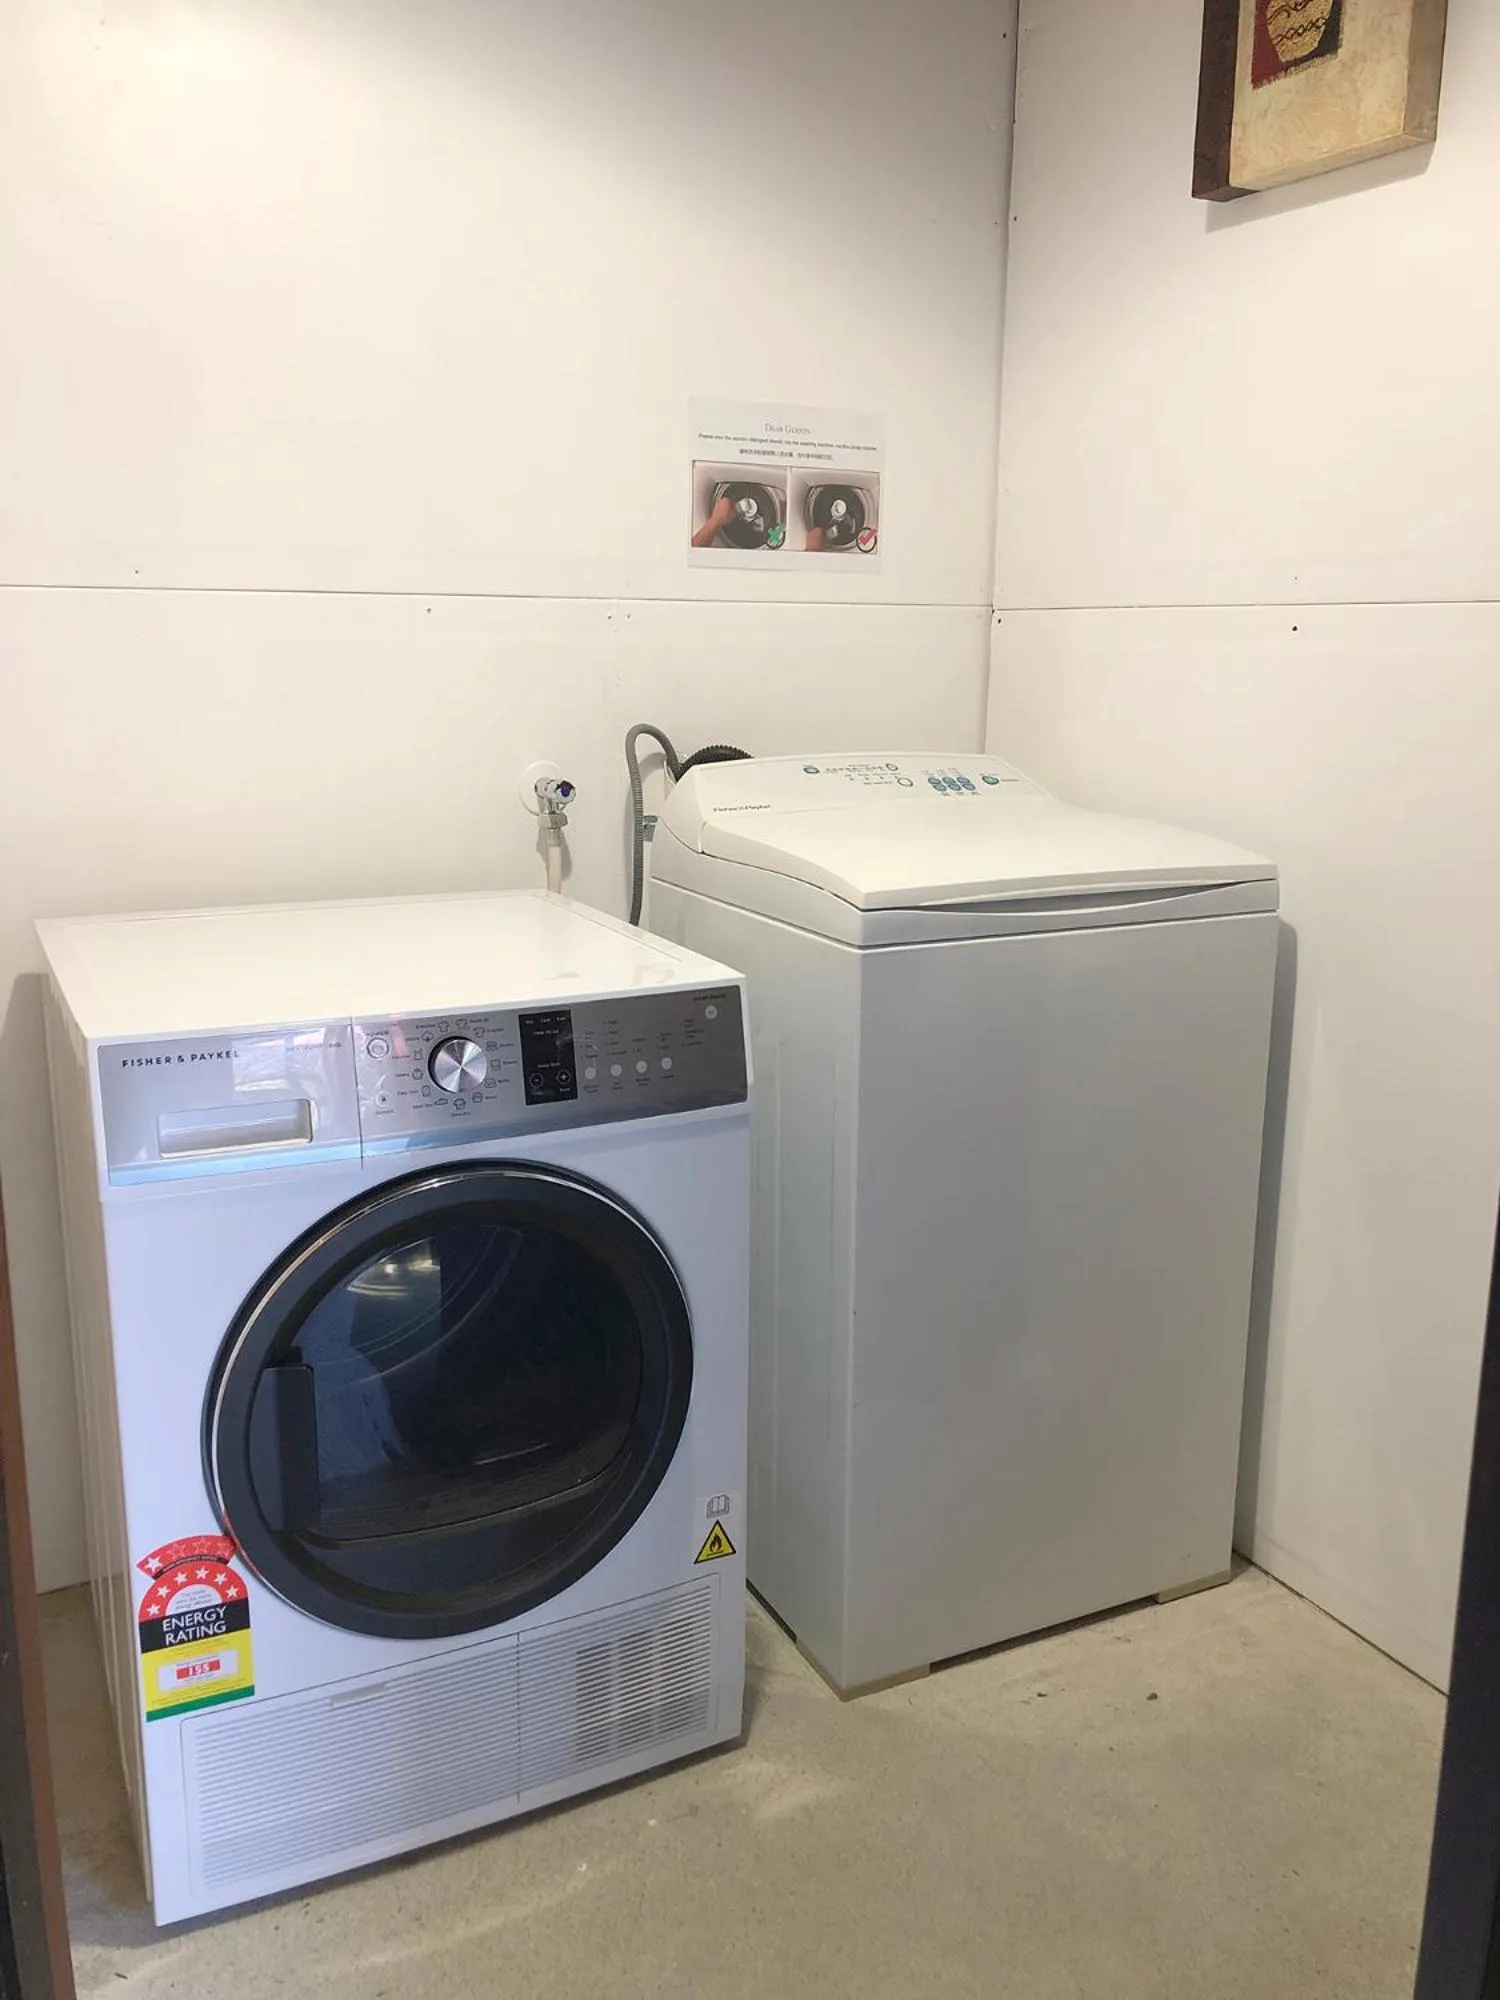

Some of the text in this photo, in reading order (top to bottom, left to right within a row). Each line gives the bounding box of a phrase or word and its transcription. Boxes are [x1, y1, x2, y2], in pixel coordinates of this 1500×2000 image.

[121, 1049, 241, 1068] FISHER & PAYKEL
[162, 1605, 227, 1632] ENERGY
[165, 1620, 227, 1646] RATING
[188, 1662, 210, 1677] 155
